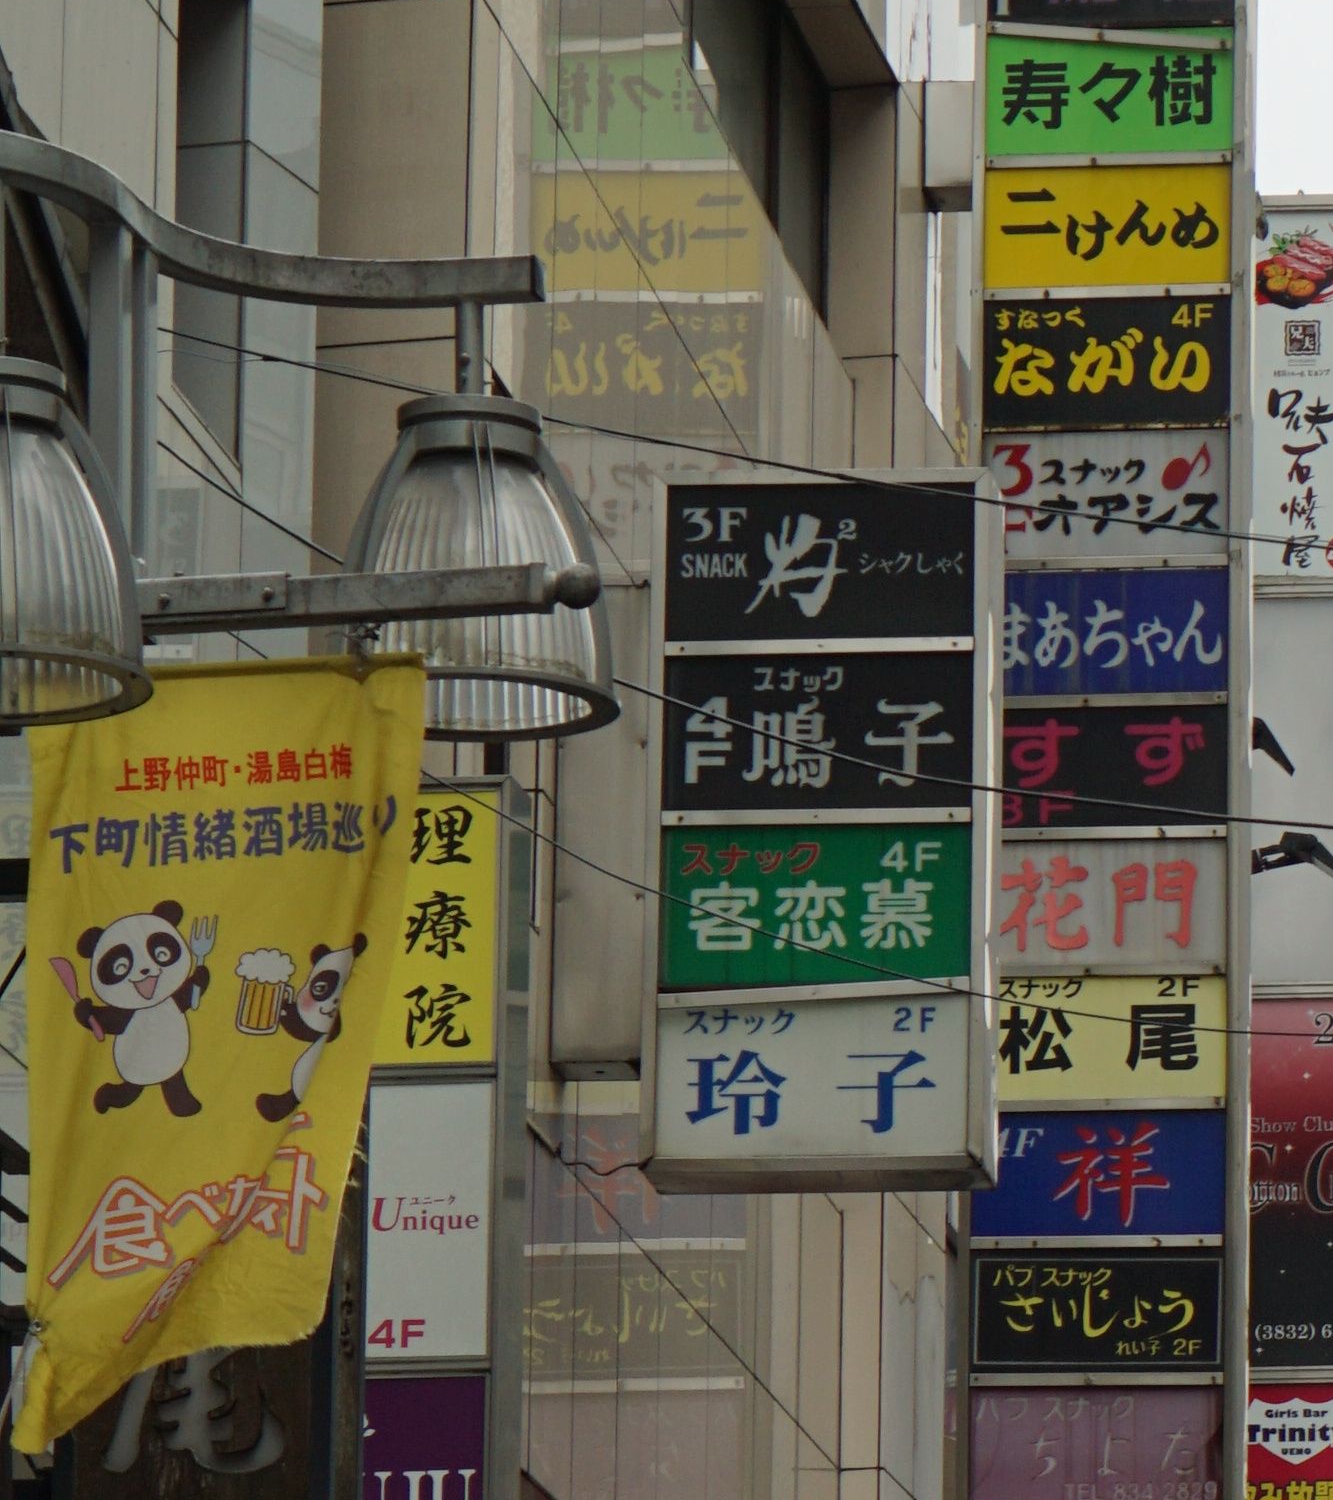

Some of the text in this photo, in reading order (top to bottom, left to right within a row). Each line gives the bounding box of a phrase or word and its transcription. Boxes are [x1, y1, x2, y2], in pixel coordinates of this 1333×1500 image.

[1001, 53, 1217, 129] 寿々樹
[1000, 187, 1221, 261] 二けんめ
[1171, 303, 1213, 328] 4F
[993, 327, 1213, 397] ながい
[1039, 457, 1146, 486] スナック
[682, 507, 748, 543] 3F
[1032, 490, 1222, 538] オアシス
[681, 552, 748, 578] SNACK
[858, 550, 964, 576] シャクしゃく
[1001, 600, 1224, 671] まあちゃん
[753, 666, 844, 693] スナック
[683, 696, 733, 785] 4F
[742, 697, 954, 788] 鳴子
[1003, 716, 1207, 789] すず
[114, 743, 353, 793] 上野仲町・湯島白梅
[50, 795, 397, 874] 下町情緒酒場巡り
[681, 841, 943, 874] スナック 4F
[688, 880, 934, 952] 客恋慕
[1001, 856, 1199, 952] 花門
[404, 803, 475, 1051] 理療院
[1000, 977, 1202, 1000] スナック 2F
[684, 1008, 937, 1036] スナック 2F
[1000, 1003, 1200, 1076] 松尾
[684, 1048, 937, 1135] 玲子
[995, 1127, 1044, 1158] 4F
[1249, 1116, 1298, 1134] Show
[1053, 1121, 1171, 1226] 祥
[371, 1195, 480, 1235] Unique
[993, 1264, 1113, 1289] パブ スナック
[367, 1318, 426, 1349] 4F
[1000, 1284, 1196, 1340] さいじょう
[1254, 1322, 1317, 1343] (3832)
[1172, 1336, 1203, 1357] 2F
[1265, 1408, 1329, 1420] Girls Bar
